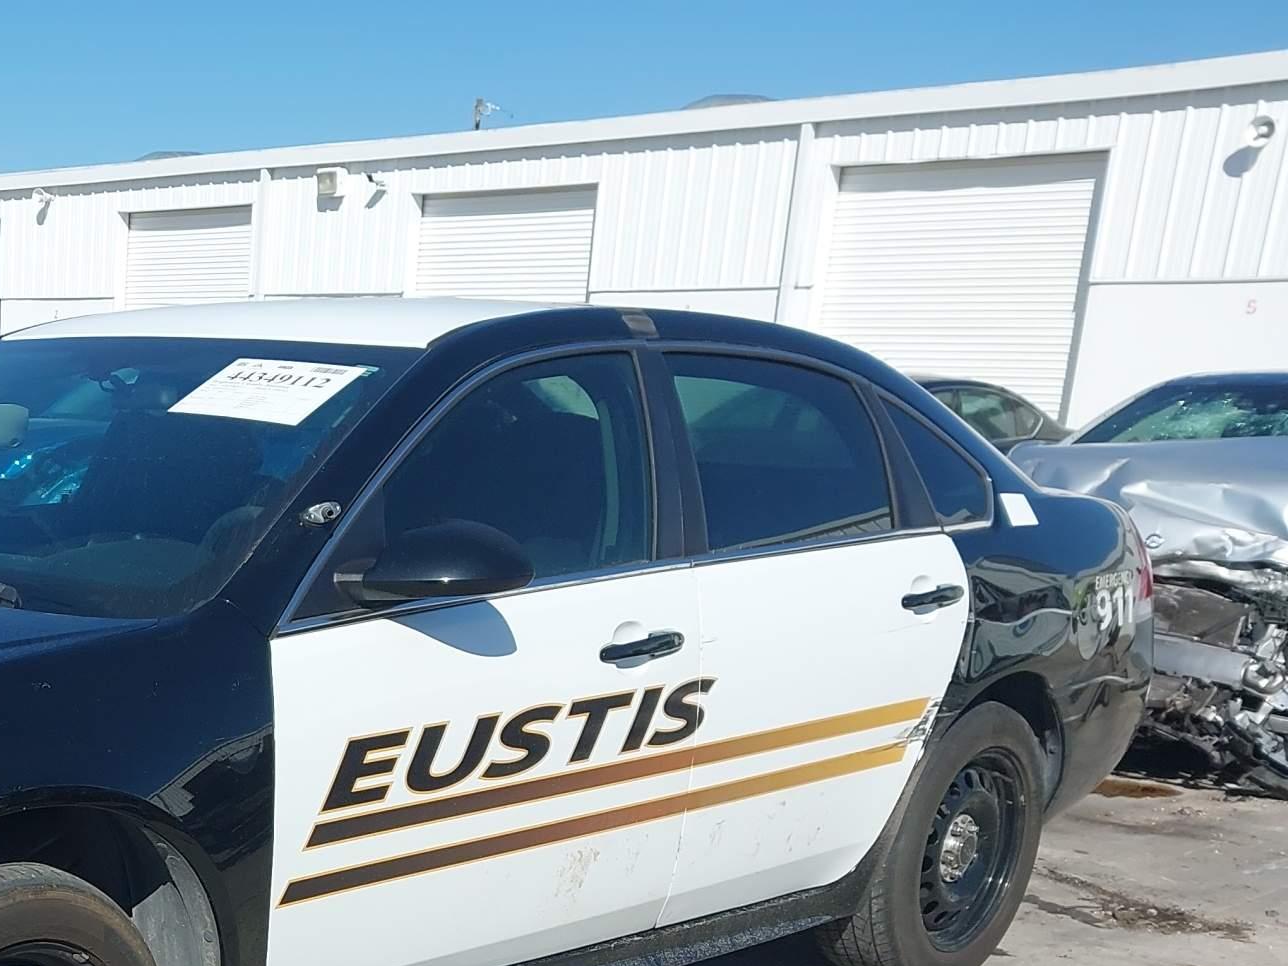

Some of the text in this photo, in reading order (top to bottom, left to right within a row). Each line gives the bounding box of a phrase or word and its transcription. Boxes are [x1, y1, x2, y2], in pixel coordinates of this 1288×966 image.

[226, 370, 332, 389] 44349112
[1096, 585, 1134, 631] 911
[318, 676, 718, 815] EUSTIS
